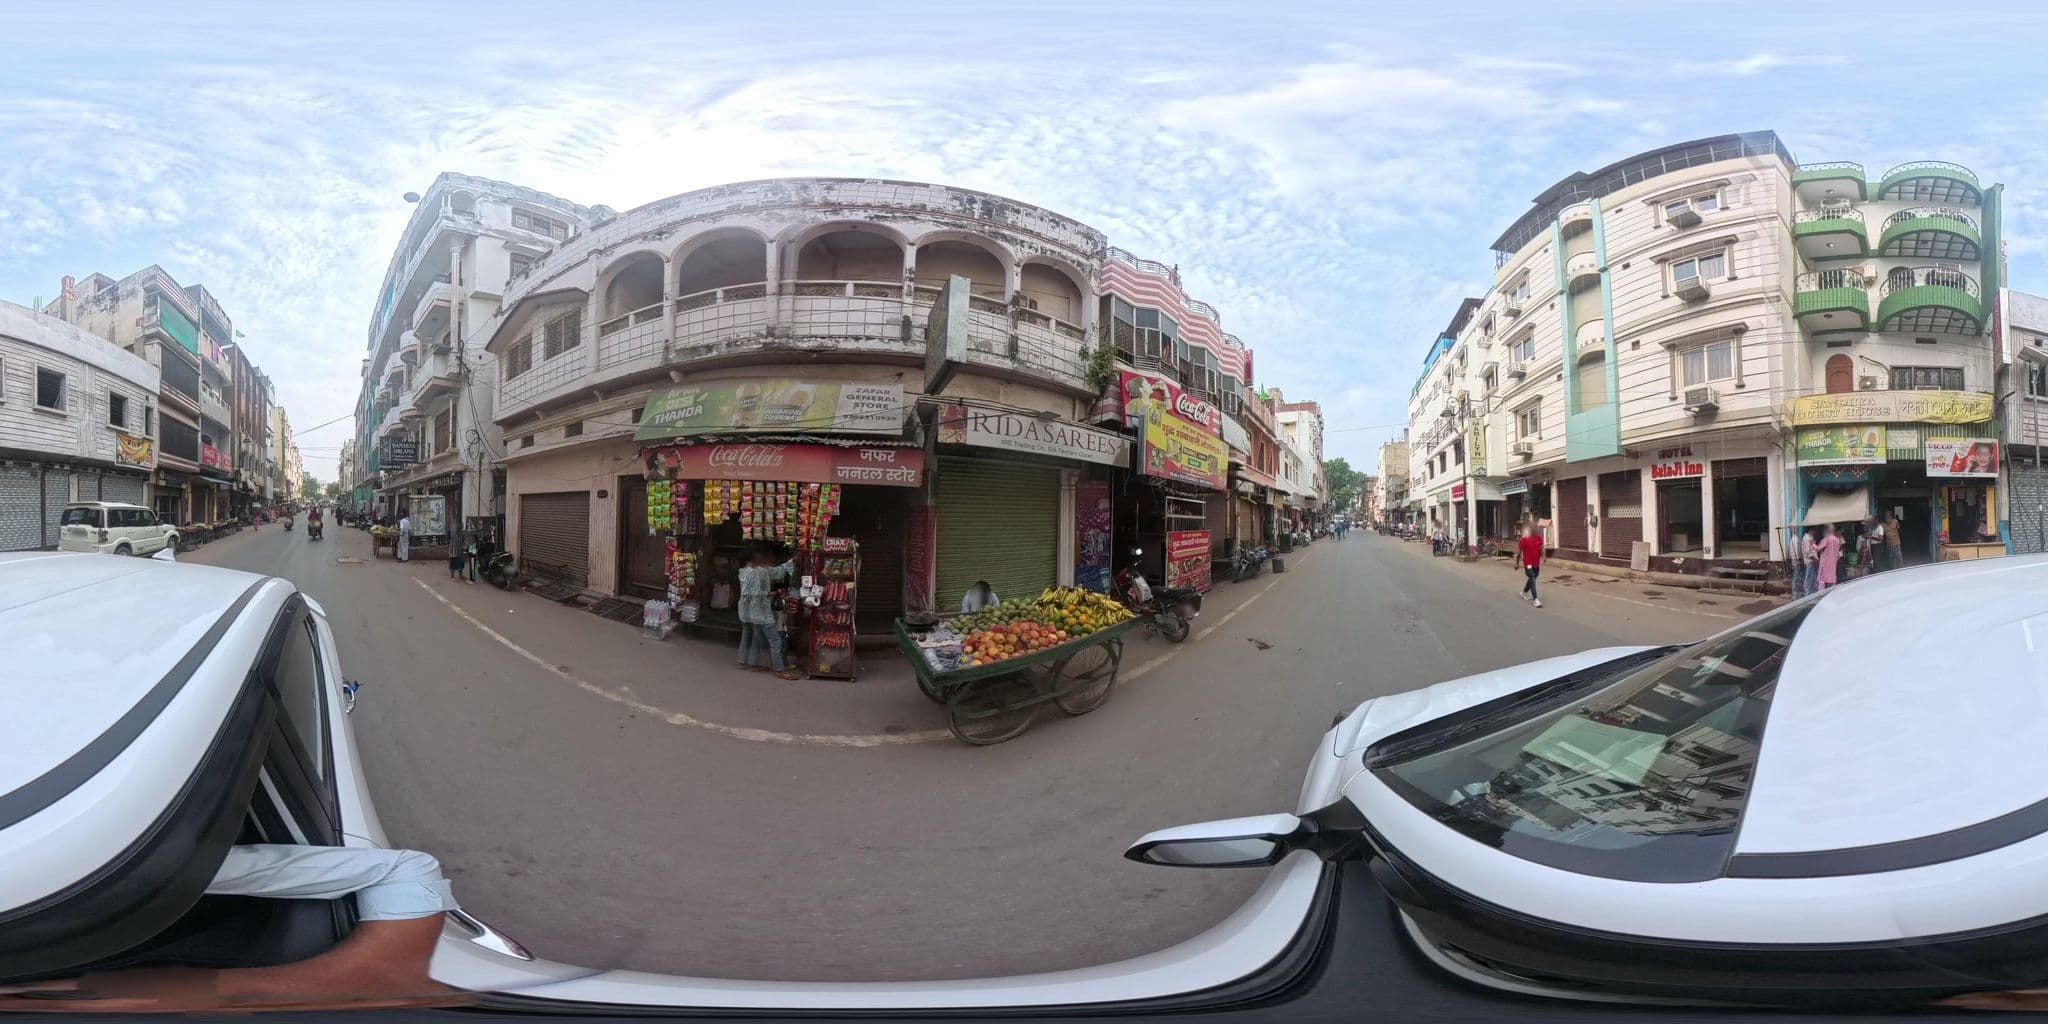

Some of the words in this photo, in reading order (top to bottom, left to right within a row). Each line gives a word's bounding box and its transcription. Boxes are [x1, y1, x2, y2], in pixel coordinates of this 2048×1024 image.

[846, 394, 898, 403] GENERAL
[853, 402, 889, 410] STORE
[654, 405, 703, 424] THANDA
[1472, 421, 1482, 457] MARILYN
[859, 448, 896, 462] जफर
[1658, 447, 1695, 459] HOTEL
[837, 466, 884, 480] जनरल
[885, 465, 916, 482] स्टोर
[1684, 460, 1704, 476] Inn
